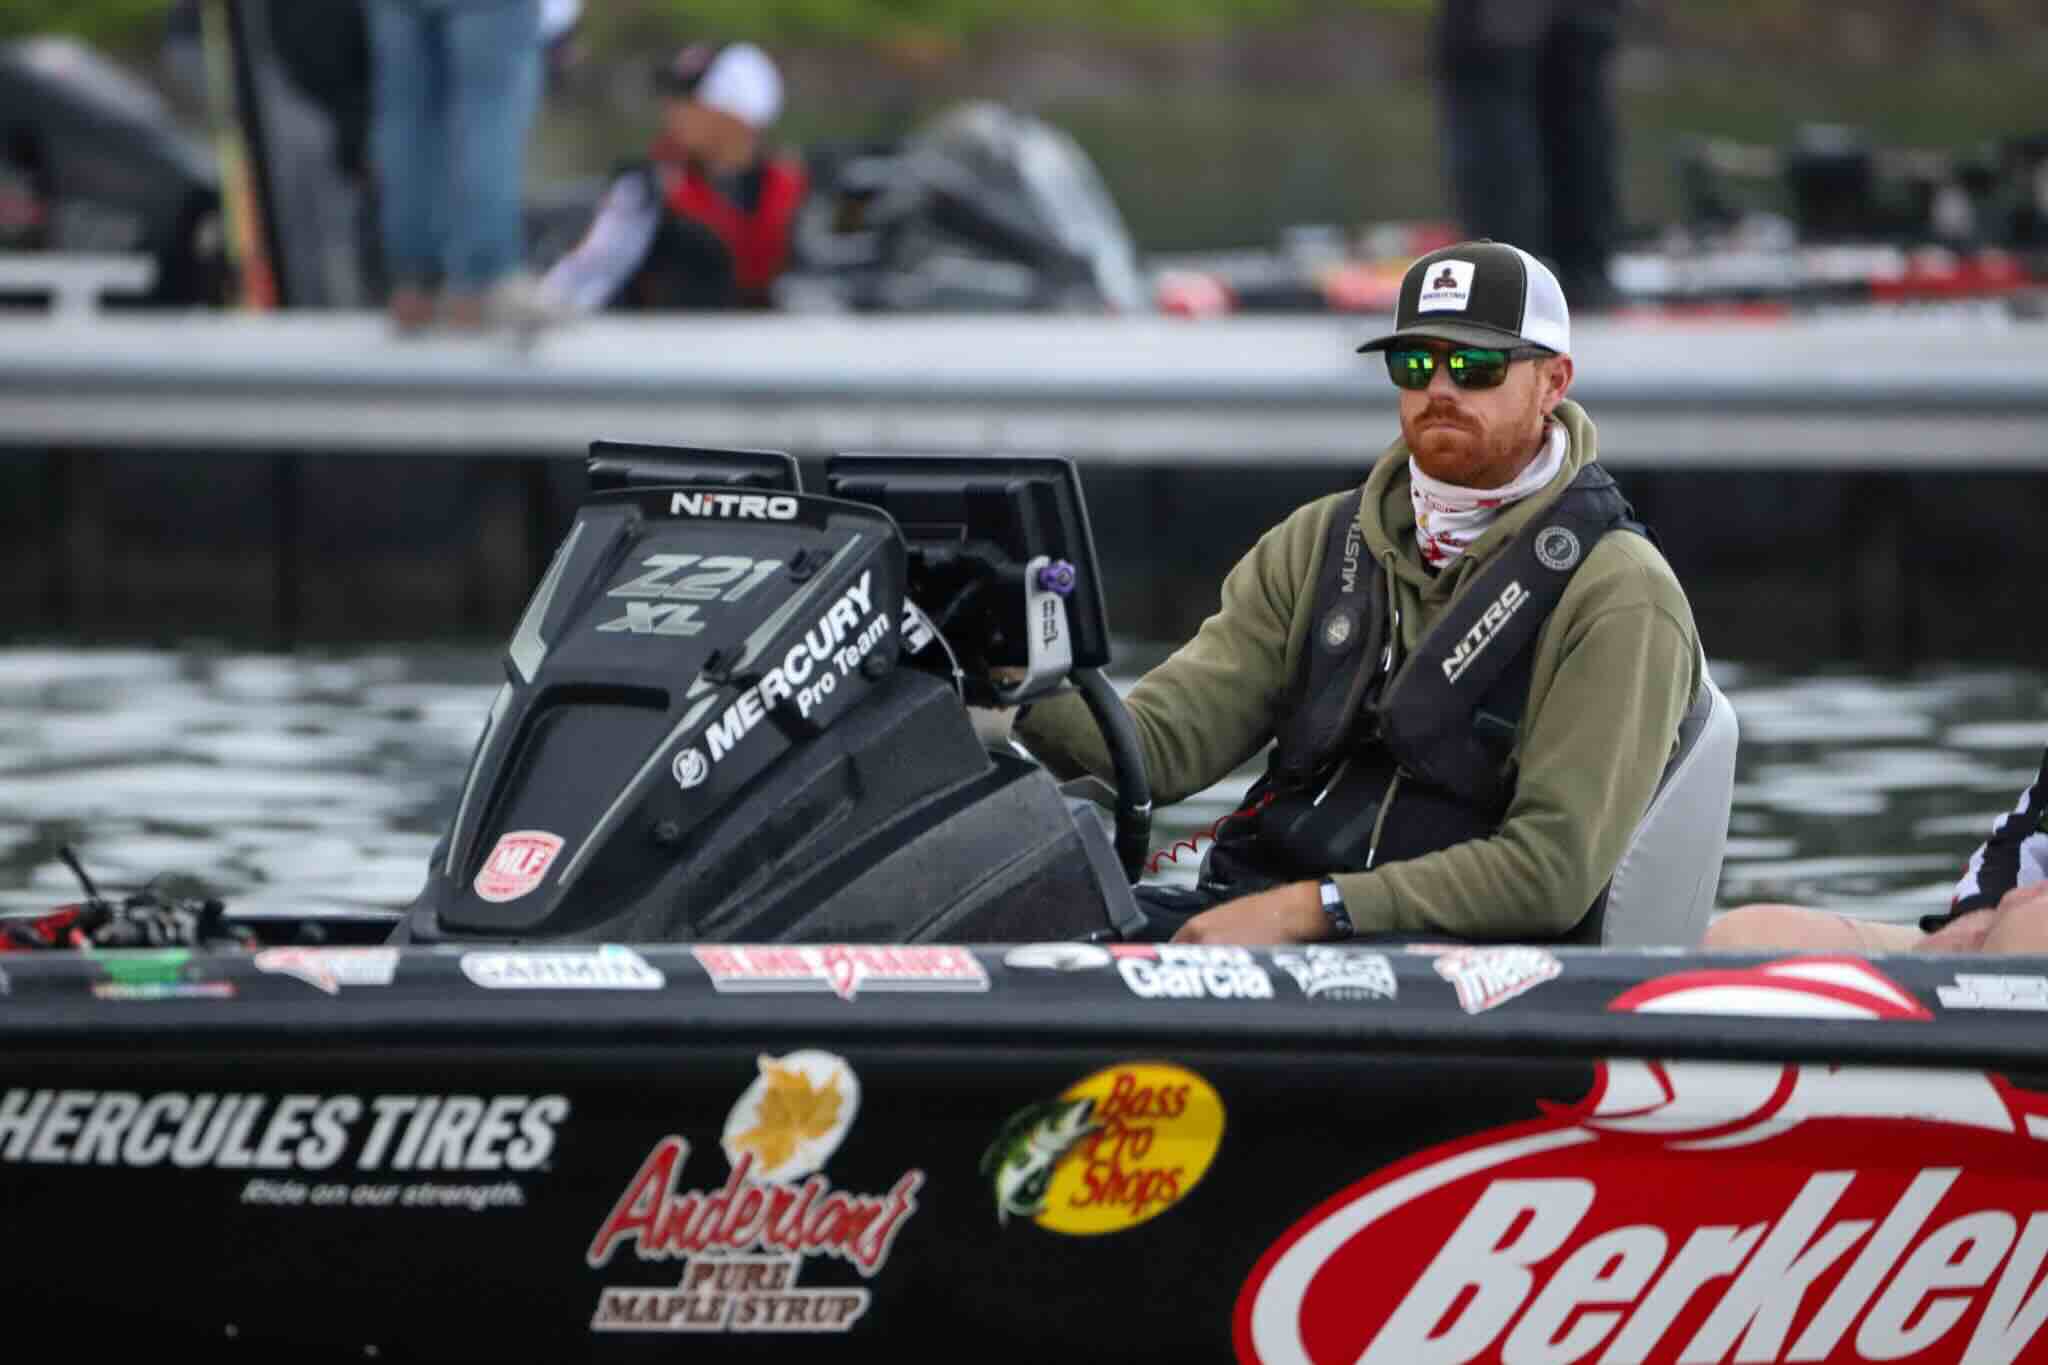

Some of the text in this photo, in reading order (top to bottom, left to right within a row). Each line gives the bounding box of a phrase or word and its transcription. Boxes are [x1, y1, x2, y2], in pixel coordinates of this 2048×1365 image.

[607, 554, 783, 602] Z21
[596, 602, 706, 635] XL
[705, 569, 871, 763] MERCURY
[797, 613, 890, 718] Pro Team
[1117, 958, 1275, 998] Garcia
[1097, 1074, 1189, 1119] Bass
[0, 1090, 570, 1170] HERCULES TIRES
[241, 1179, 307, 1204] Ride
[311, 1186, 349, 1205] on
[351, 1186, 399, 1205] our
[1070, 1167, 1184, 1215] Shops
[691, 1262, 792, 1291] PURE
[603, 1296, 861, 1323] MAPLE SYRUP
